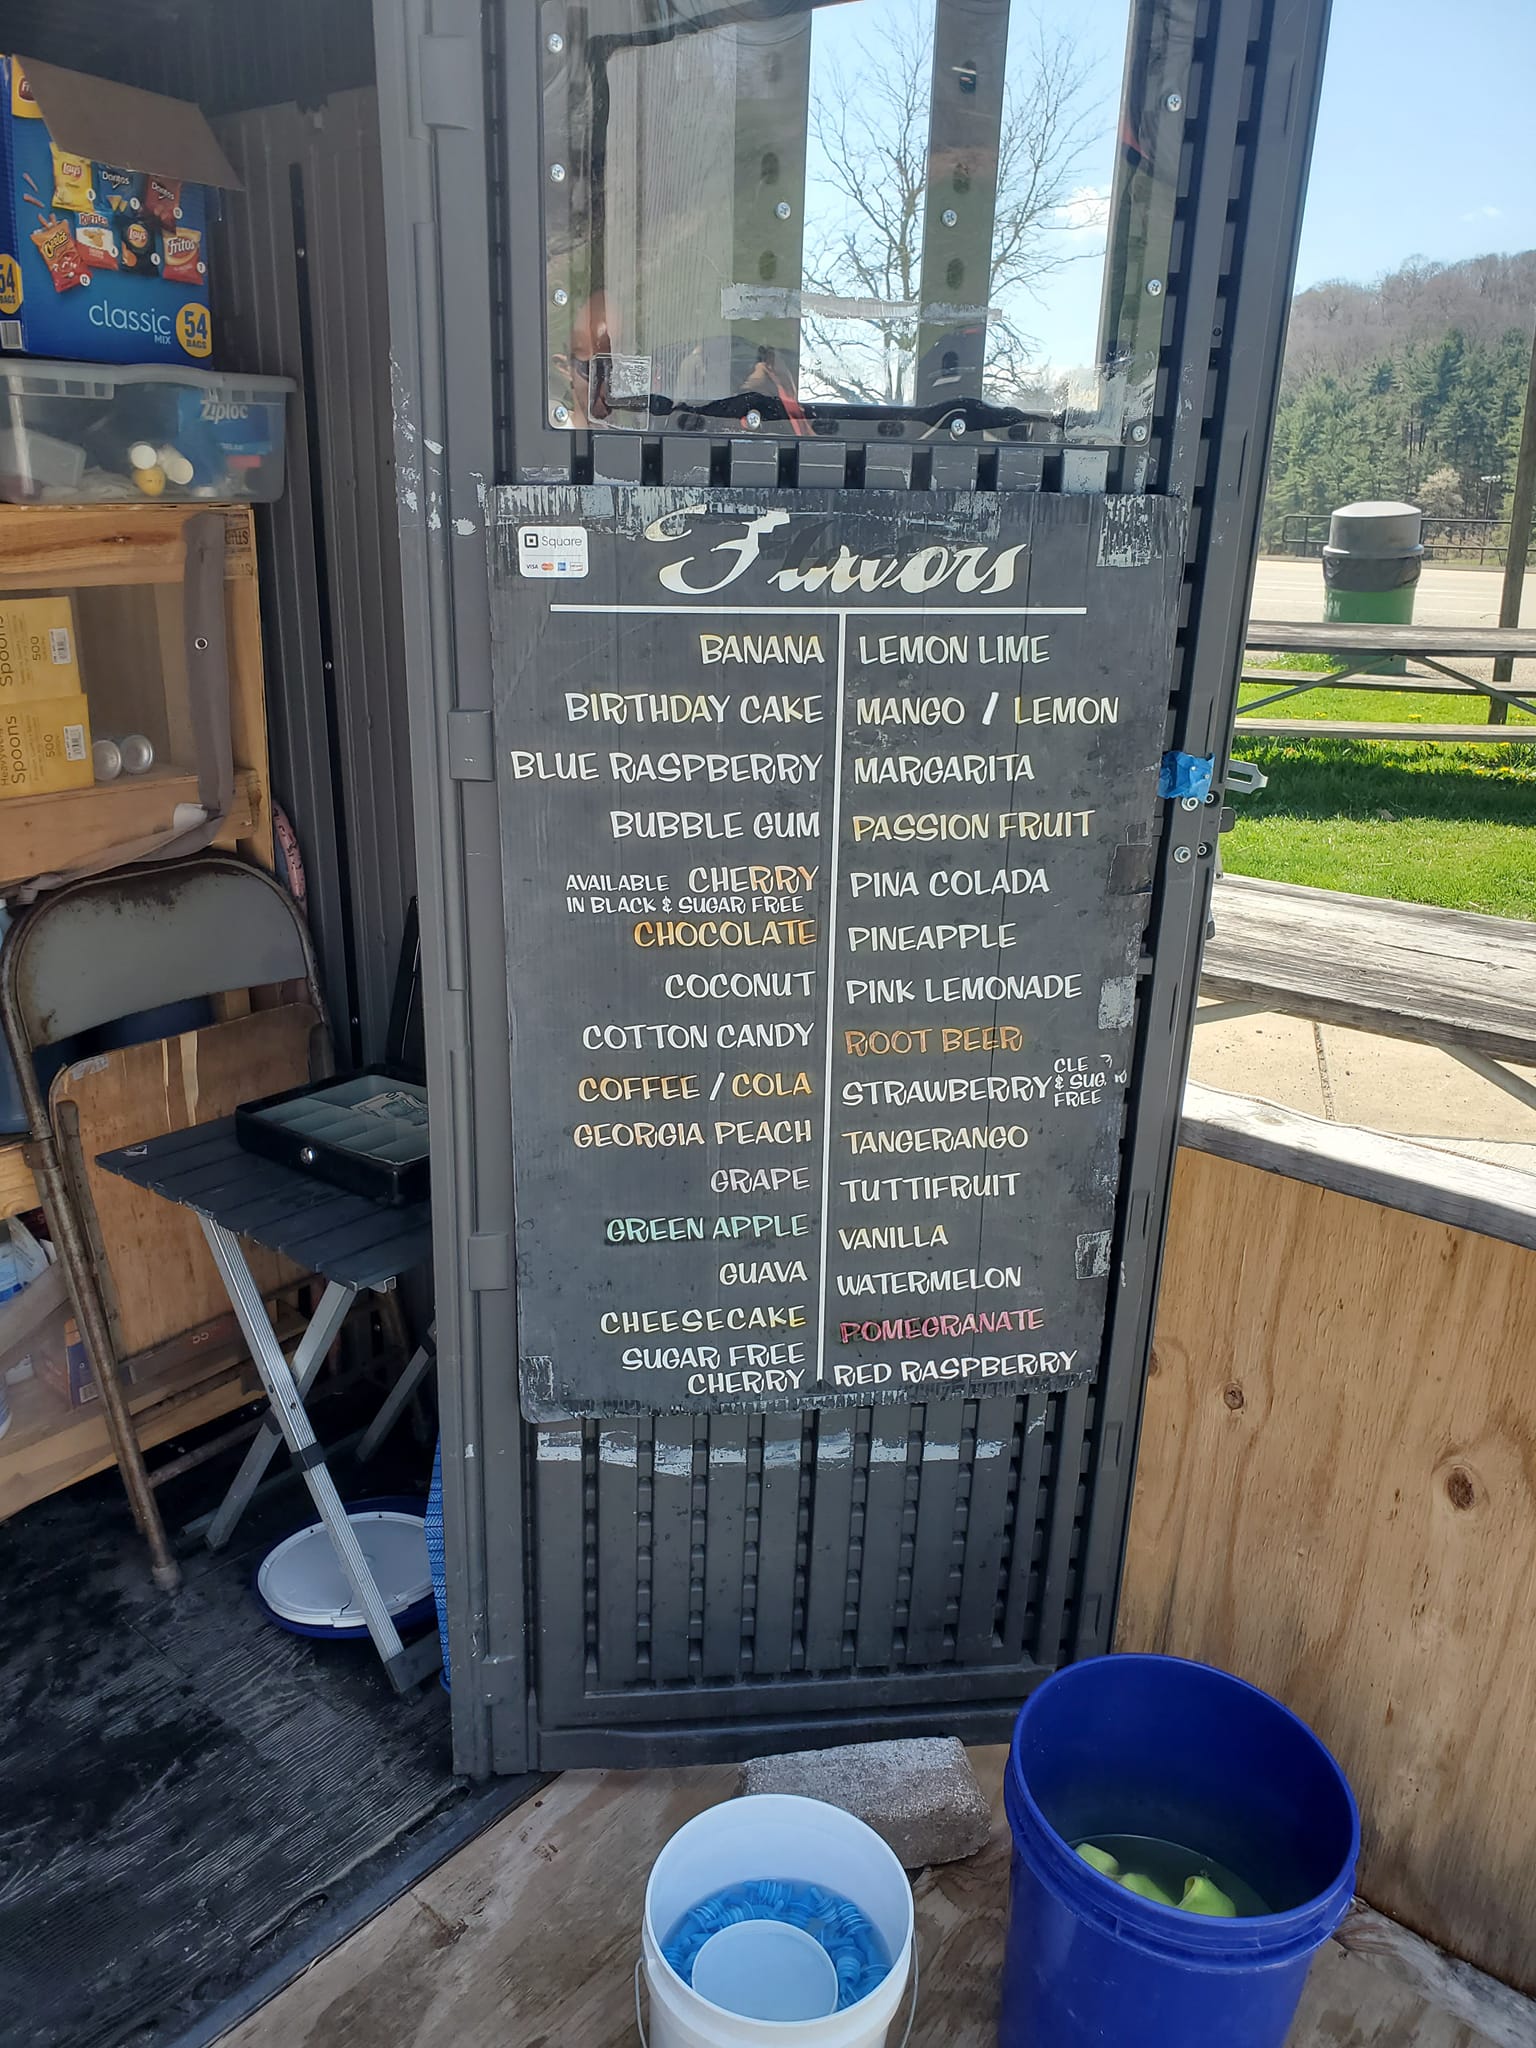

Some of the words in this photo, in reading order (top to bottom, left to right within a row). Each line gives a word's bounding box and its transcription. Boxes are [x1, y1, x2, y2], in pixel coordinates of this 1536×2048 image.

[88, 299, 172, 335] classic
[183, 310, 208, 340] 54
[153, 333, 172, 345] MIX
[185, 338, 207, 350] BAGS
[201, 401, 249, 424] Ziploc
[540, 535, 584, 549] Square
[526, 563, 539, 571] VISA
[30, 635, 42, 662] 500
[699, 634, 826, 665] BANANA
[859, 635, 968, 665] LEMON
[978, 634, 1050, 664] LIME
[564, 692, 731, 725] BIRTHDAY
[739, 694, 824, 724] CAKE
[856, 696, 965, 726] MANGO
[981, 691, 1000, 726] /
[1014, 696, 1119, 725] LEMON
[6, 715, 27, 784] Spoons
[43, 733, 57, 759] 500
[510, 750, 600, 781] BLUE
[608, 752, 823, 785] RASPBERRY
[854, 753, 1035, 786] MARGARITA
[609, 810, 744, 840] BUBBLE
[753, 811, 821, 839] GUM
[852, 812, 990, 842] PASSION
[998, 809, 1096, 841] FRUIT
[566, 874, 670, 892] AVAILABLE
[688, 865, 820, 895] CHERRY
[850, 871, 920, 898] PINA
[929, 868, 1051, 897] COLADA
[566, 896, 585, 913] IN
[590, 896, 657, 914] BLACK
[678, 896, 746, 915] SUGAR
[751, 895, 805, 914] FREE
[634, 919, 817, 947] CHOCOLATE
[847, 922, 1017, 952] PINEAPPLE
[664, 970, 816, 999] COCONUT
[846, 979, 916, 1005] PINK
[925, 973, 1082, 1003] LEMONADE
[582, 1024, 708, 1050] COTTON
[716, 1022, 815, 1049] CANDY
[844, 1028, 933, 1057] ROOT
[941, 1026, 1023, 1053] BEER
[578, 1074, 701, 1102] COFFEE
[709, 1071, 726, 1101] /
[731, 1072, 813, 1097] COLA
[842, 1075, 1053, 1106] STRAWBERRY
[1054, 1089, 1102, 1107] FREE
[573, 1122, 706, 1149] GEORGIA
[714, 1119, 812, 1145] PEACH
[841, 1125, 1029, 1155] TANGERANGO
[710, 1166, 811, 1194] GRAPE
[839, 1172, 1022, 1203] TUTTIFRUIT
[606, 1217, 704, 1243] GREEN
[712, 1213, 809, 1240] APPLE
[838, 1224, 949, 1251] VANILLA
[719, 1260, 808, 1286] GUAVA
[836, 1266, 1022, 1297] WATERMELON
[600, 1305, 807, 1334] CHEESECAKE
[839, 1307, 1044, 1344] POMEGRANATE
[621, 1346, 721, 1371] SUGAR
[728, 1342, 806, 1368] FREE
[833, 1363, 892, 1388] RED
[900, 1349, 1078, 1384] RASPBERRY
[687, 1368, 806, 1395] CHERRY
